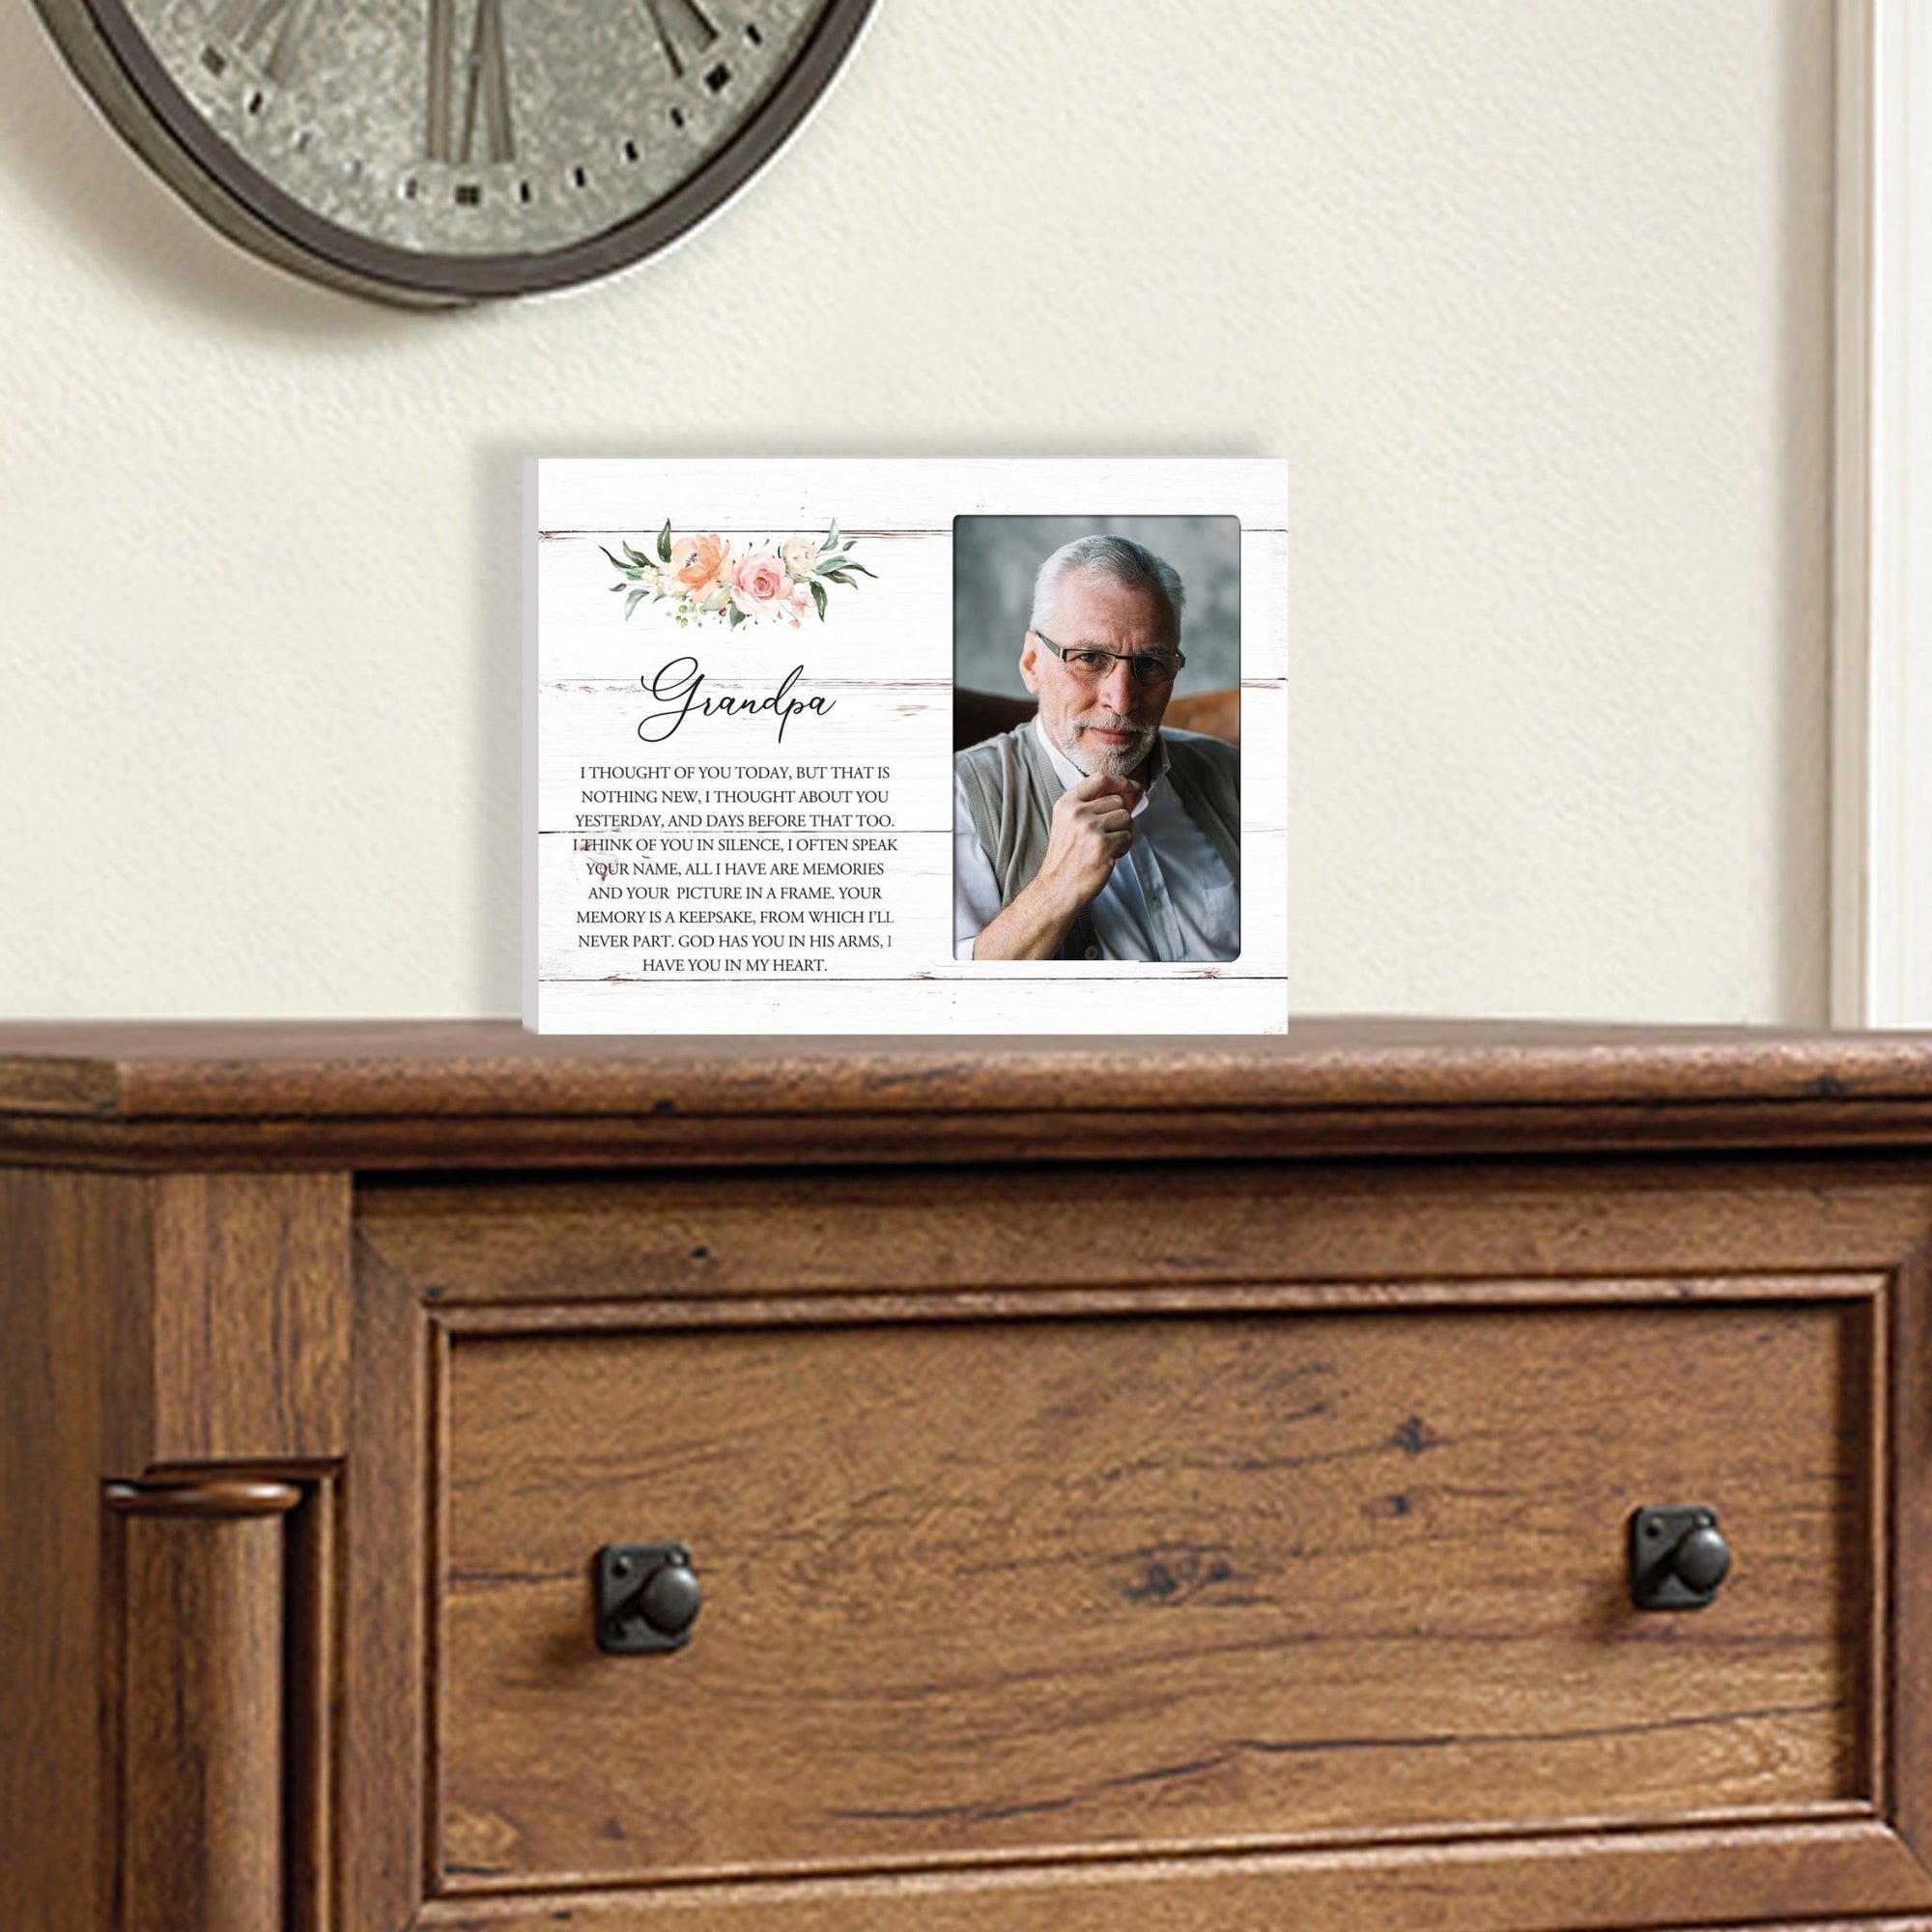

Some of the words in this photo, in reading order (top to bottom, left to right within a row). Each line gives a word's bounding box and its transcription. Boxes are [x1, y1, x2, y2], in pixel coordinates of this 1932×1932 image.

[638, 656, 837, 744] Grandpa
[581, 766, 585, 780] I
[588, 766, 671, 780] THOUGHT
[673, 766, 696, 780] OF
[697, 766, 731, 780] YOU
[734, 766, 793, 781] TODAY,
[796, 766, 828, 780] BUT
[830, 766, 874, 780] THAT
[877, 766, 891, 780] IS
[582, 790, 658, 804] NOTHING
[662, 790, 701, 805] NEW,
[705, 790, 710, 804] I
[713, 790, 796, 804] THOUGHT
[798, 790, 853, 804] ABOUT
[855, 790, 890, 804] YOU
[575, 814, 665, 829] YESTERDAY,
[668, 814, 702, 827] AND
[706, 814, 745, 828] DAYS
[748, 814, 807, 828] BEFORE
[809, 814, 853, 828] THAT
[855, 814, 895, 828] TOO.
[573, 838, 578, 851] I
[580, 838, 633, 852] THINK
[636, 838, 657, 852] OF
[660, 838, 694, 852] YOU
[696, 838, 715, 851] IN
[718, 838, 784, 853] SILENCE,
[787, 838, 792, 851] I
[796, 838, 849, 852] OFTEN
[852, 838, 898, 852] SPEAK
[585, 862, 630, 875] YOUR
[633, 863, 682, 876] NAME,
[684, 863, 713, 875] ALL
[716, 863, 721, 875] I
[724, 863, 767, 875] HAVE
[769, 863, 800, 875] ARE
[802, 863, 885, 875] MEMORIES
[587, 887, 623, 899] AND
[626, 886, 670, 899] YOUR
[676, 887, 743, 899] PICTURE
[746, 887, 763, 899] IN
[766, 887, 777, 899] A
[781, 887, 835, 899] FRAME.
[838, 886, 882, 899] YOUR
[576, 910, 646, 923] MEMORY
[649, 910, 662, 923] IS
[665, 911, 676, 923] A
[678, 910, 756, 924] KEEPSAKE,
[759, 910, 805, 923] FROM
[808, 910, 865, 923] WHICH
[868, 910, 895, 923] I’LL
[578, 934, 630, 948] NEVER
[633, 934, 674, 948] PART.
[678, 934, 715, 948] GOD
[719, 934, 749, 948] HAS
[752, 934, 784, 948] YOU
[788, 934, 806, 948] IN
[810, 935, 835, 948] HIS
[838, 934, 884, 949] ARMS,
[888, 935, 892, 948] I
[642, 958, 685, 972] HAVE
[687, 958, 721, 972] YOU
[724, 958, 742, 972] IN
[746, 958, 770, 972] MY
[773, 958, 828, 972] HEART.
